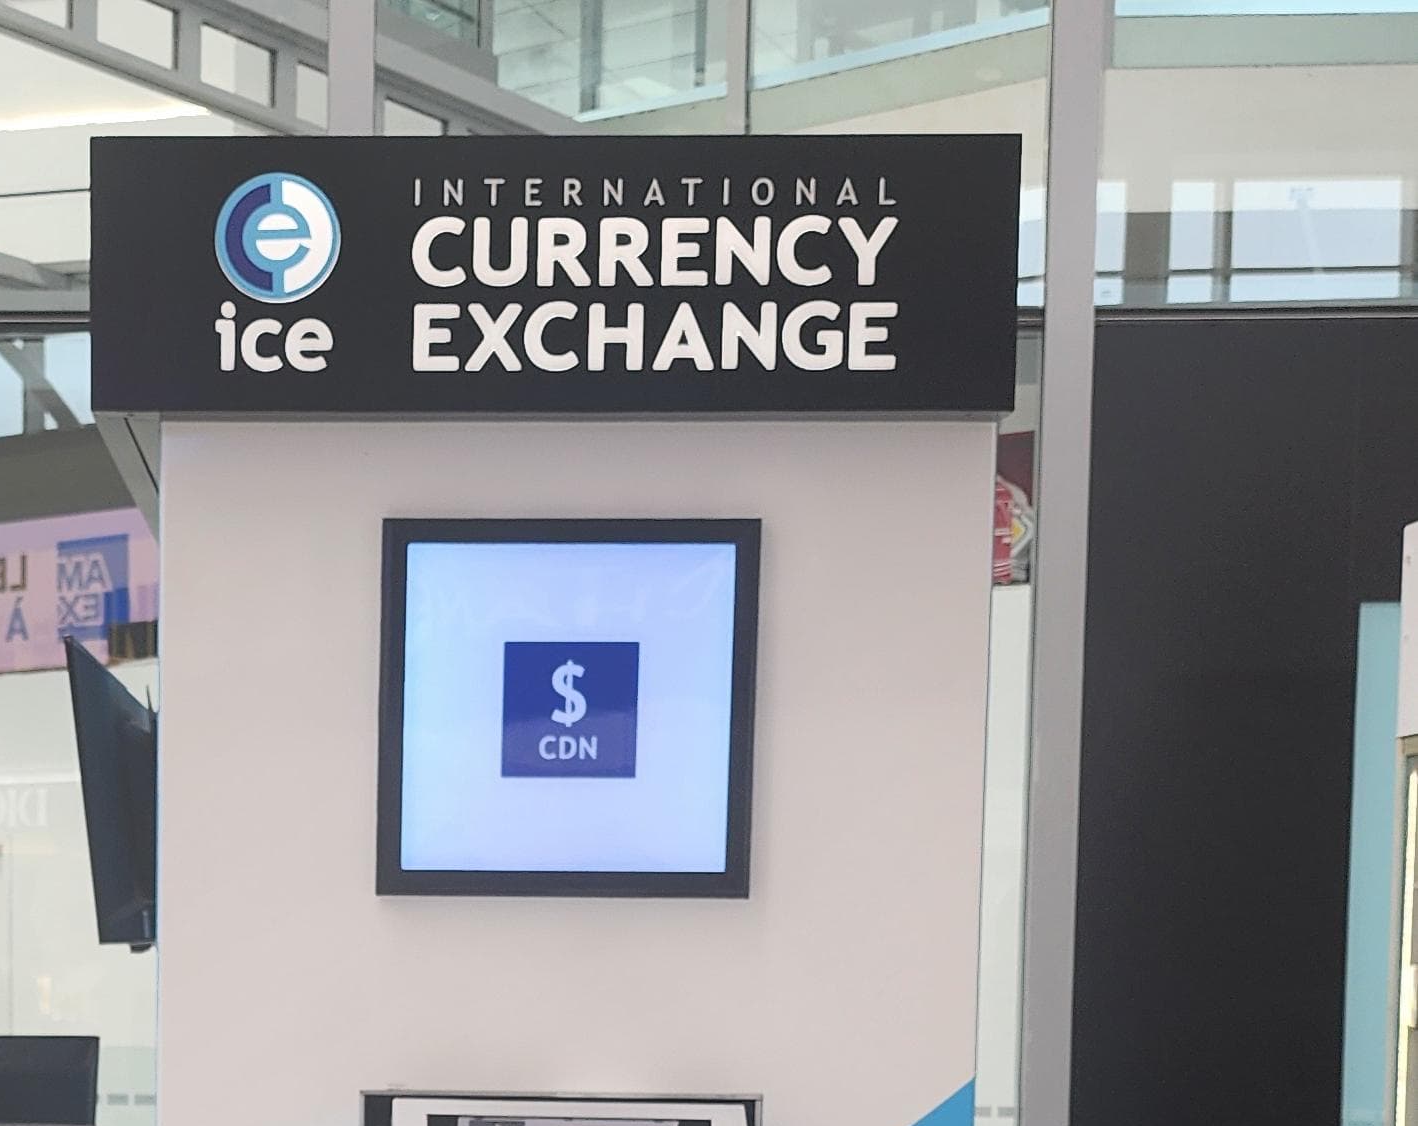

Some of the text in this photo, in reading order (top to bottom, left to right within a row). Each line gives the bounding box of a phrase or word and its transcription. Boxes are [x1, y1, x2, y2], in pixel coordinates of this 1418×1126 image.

[413, 177, 898, 206] INTERNATIONAL
[411, 216, 899, 287] CURRENCY
[214, 300, 334, 373] ice
[411, 301, 899, 372] EXCHANGE
[538, 735, 598, 761] CDN
